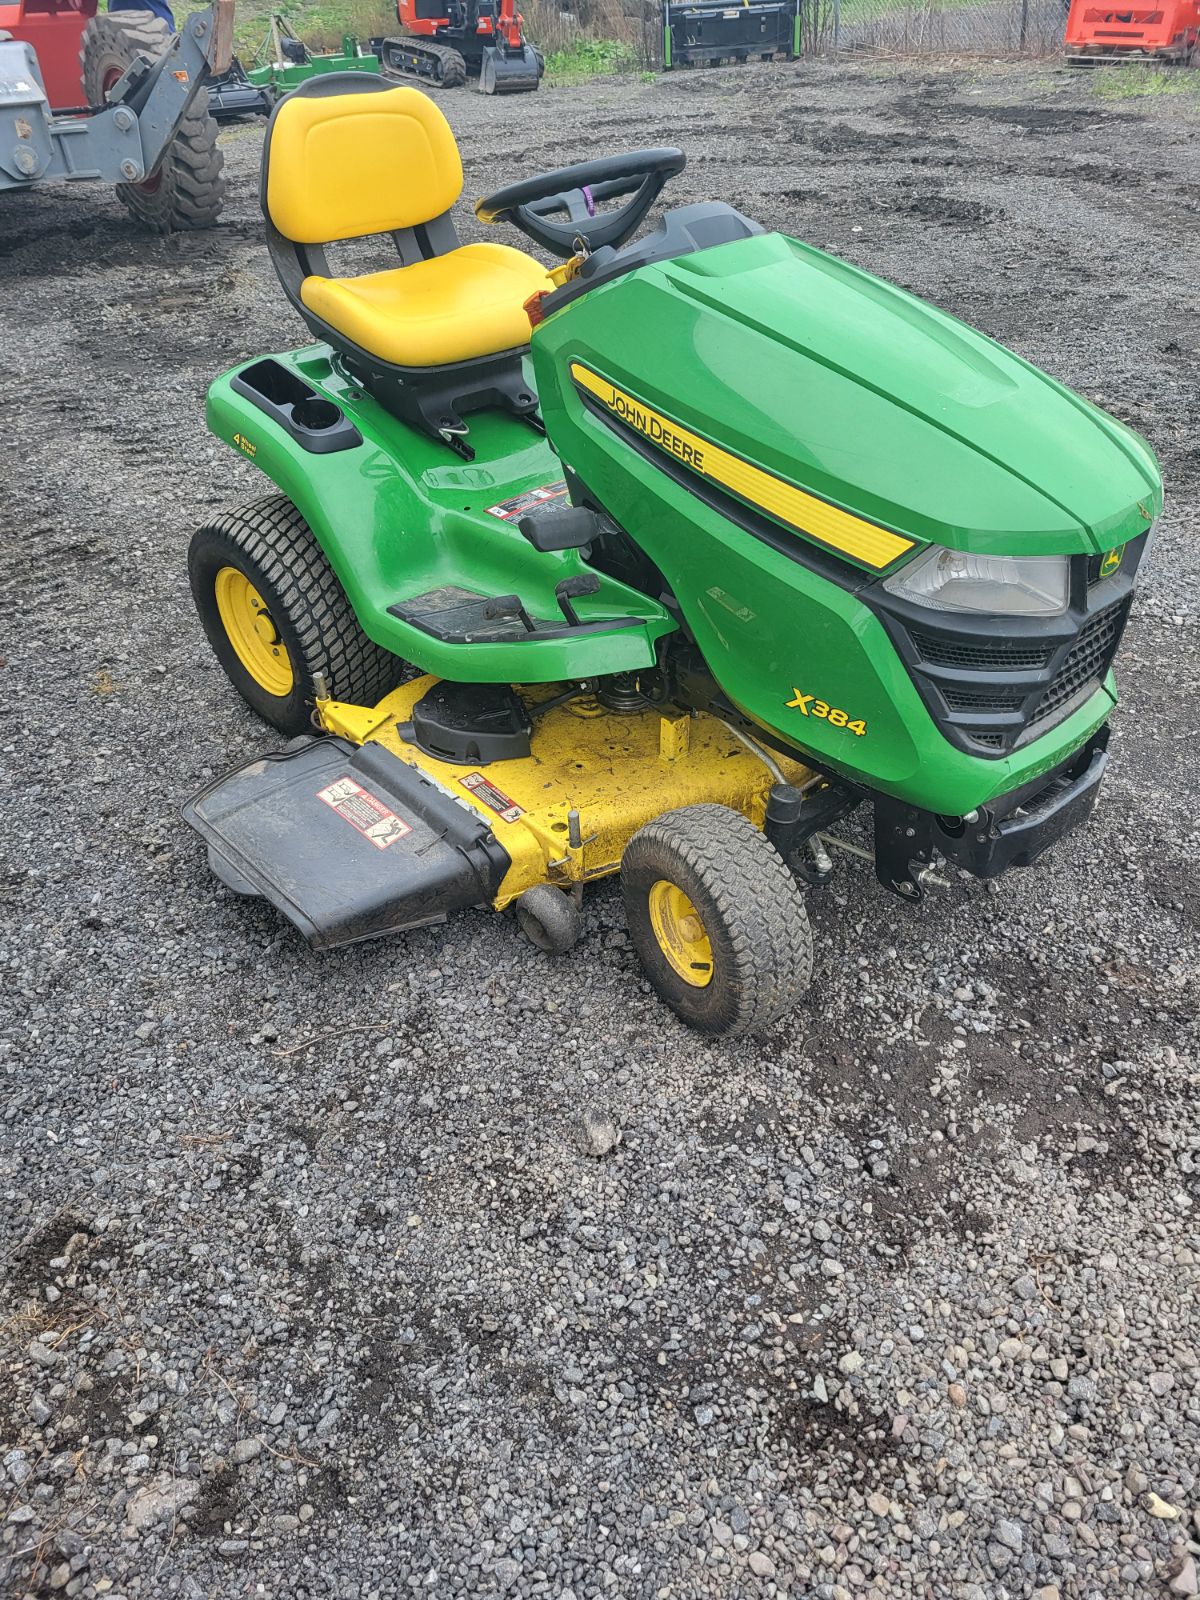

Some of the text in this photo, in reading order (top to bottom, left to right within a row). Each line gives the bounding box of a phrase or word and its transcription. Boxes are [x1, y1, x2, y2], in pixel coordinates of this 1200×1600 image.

[233, 433, 240, 445] 4
[607, 389, 704, 470] JOHN DEERE
[784, 687, 866, 736] X384
[365, 795, 389, 815] DANGER
